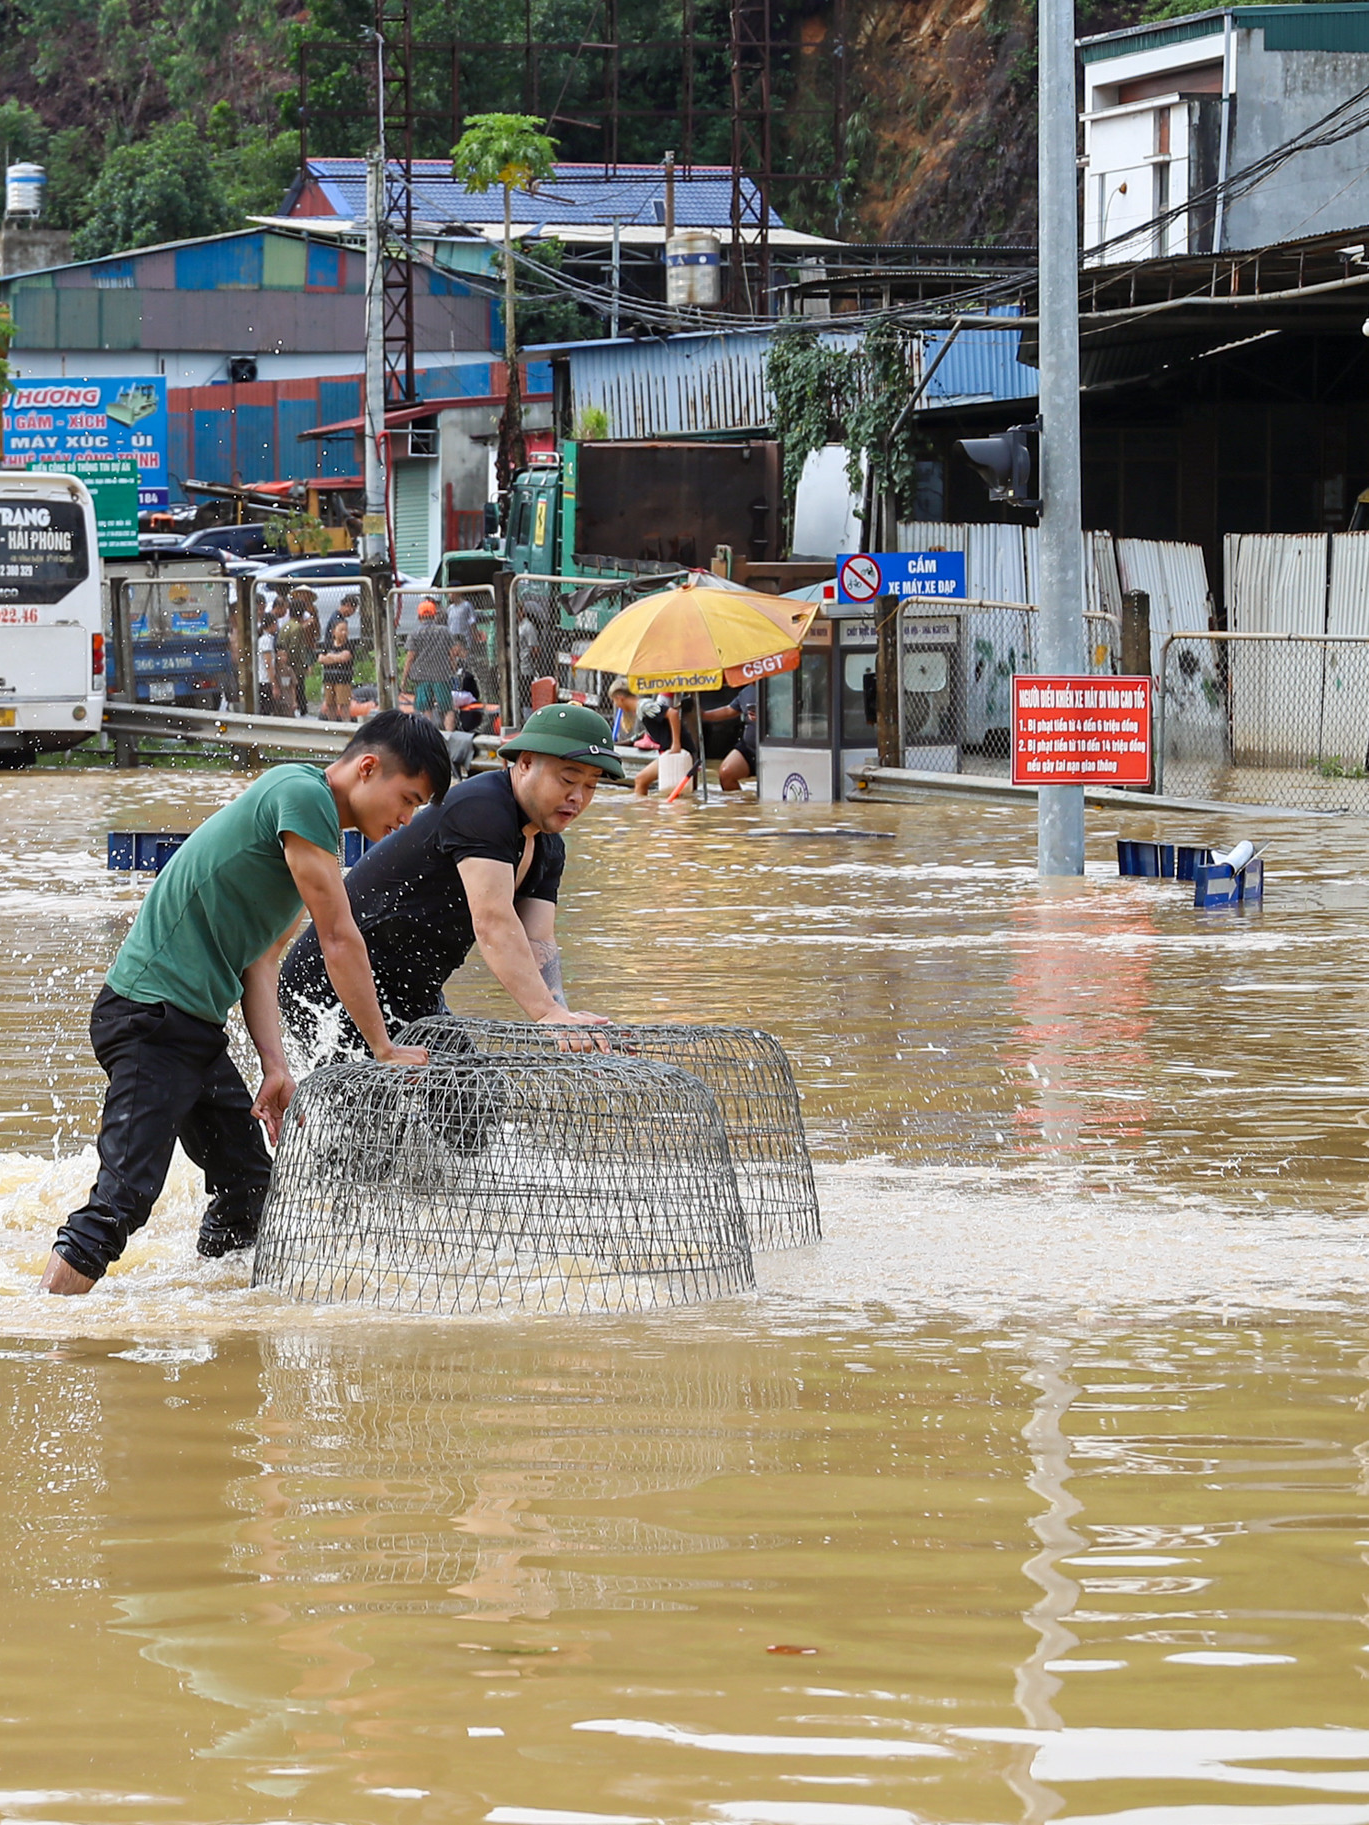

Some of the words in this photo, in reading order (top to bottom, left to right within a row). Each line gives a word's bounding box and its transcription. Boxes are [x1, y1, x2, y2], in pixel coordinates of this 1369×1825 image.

[67, 412, 108, 430] XÍCH
[10, 434, 59, 449] MÁY
[65, 432, 109, 448] XÚC
[8, 525, 29, 550] HẢI
[31, 527, 72, 551] PHÒNG
[907, 555, 937, 574] CẤM
[888, 581, 901, 595] XE
[937, 579, 957, 596] ĐẠP
[742, 654, 783, 679] CSGT
[637, 673, 718, 691] Eurowindow
[1074, 690, 1084, 709] XE
[1018, 719, 1027, 732] 1.
[1076, 719, 1082, 732] 4
[1097, 719, 1103, 732] 6
[1018, 739, 1027, 752] 2.
[1077, 739, 1086, 752] 10
[1101, 739, 1111, 752] 14
